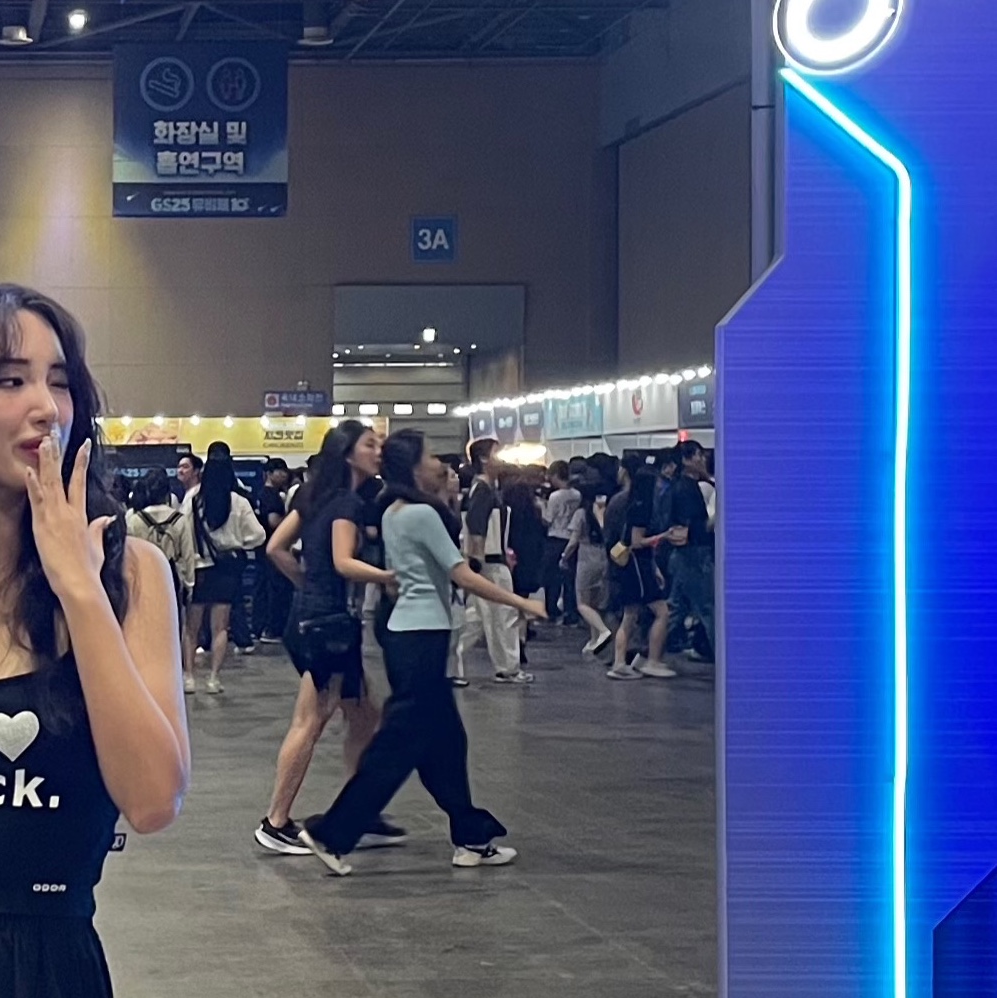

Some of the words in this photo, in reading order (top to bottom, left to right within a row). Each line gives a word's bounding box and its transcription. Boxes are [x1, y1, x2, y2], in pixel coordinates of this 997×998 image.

[153, 120, 219, 145] 화장실
[226, 121, 247, 145] 및
[157, 151, 244, 176] 흡연구역
[150, 197, 191, 212] GS25
[417, 228, 449, 250] 3A
